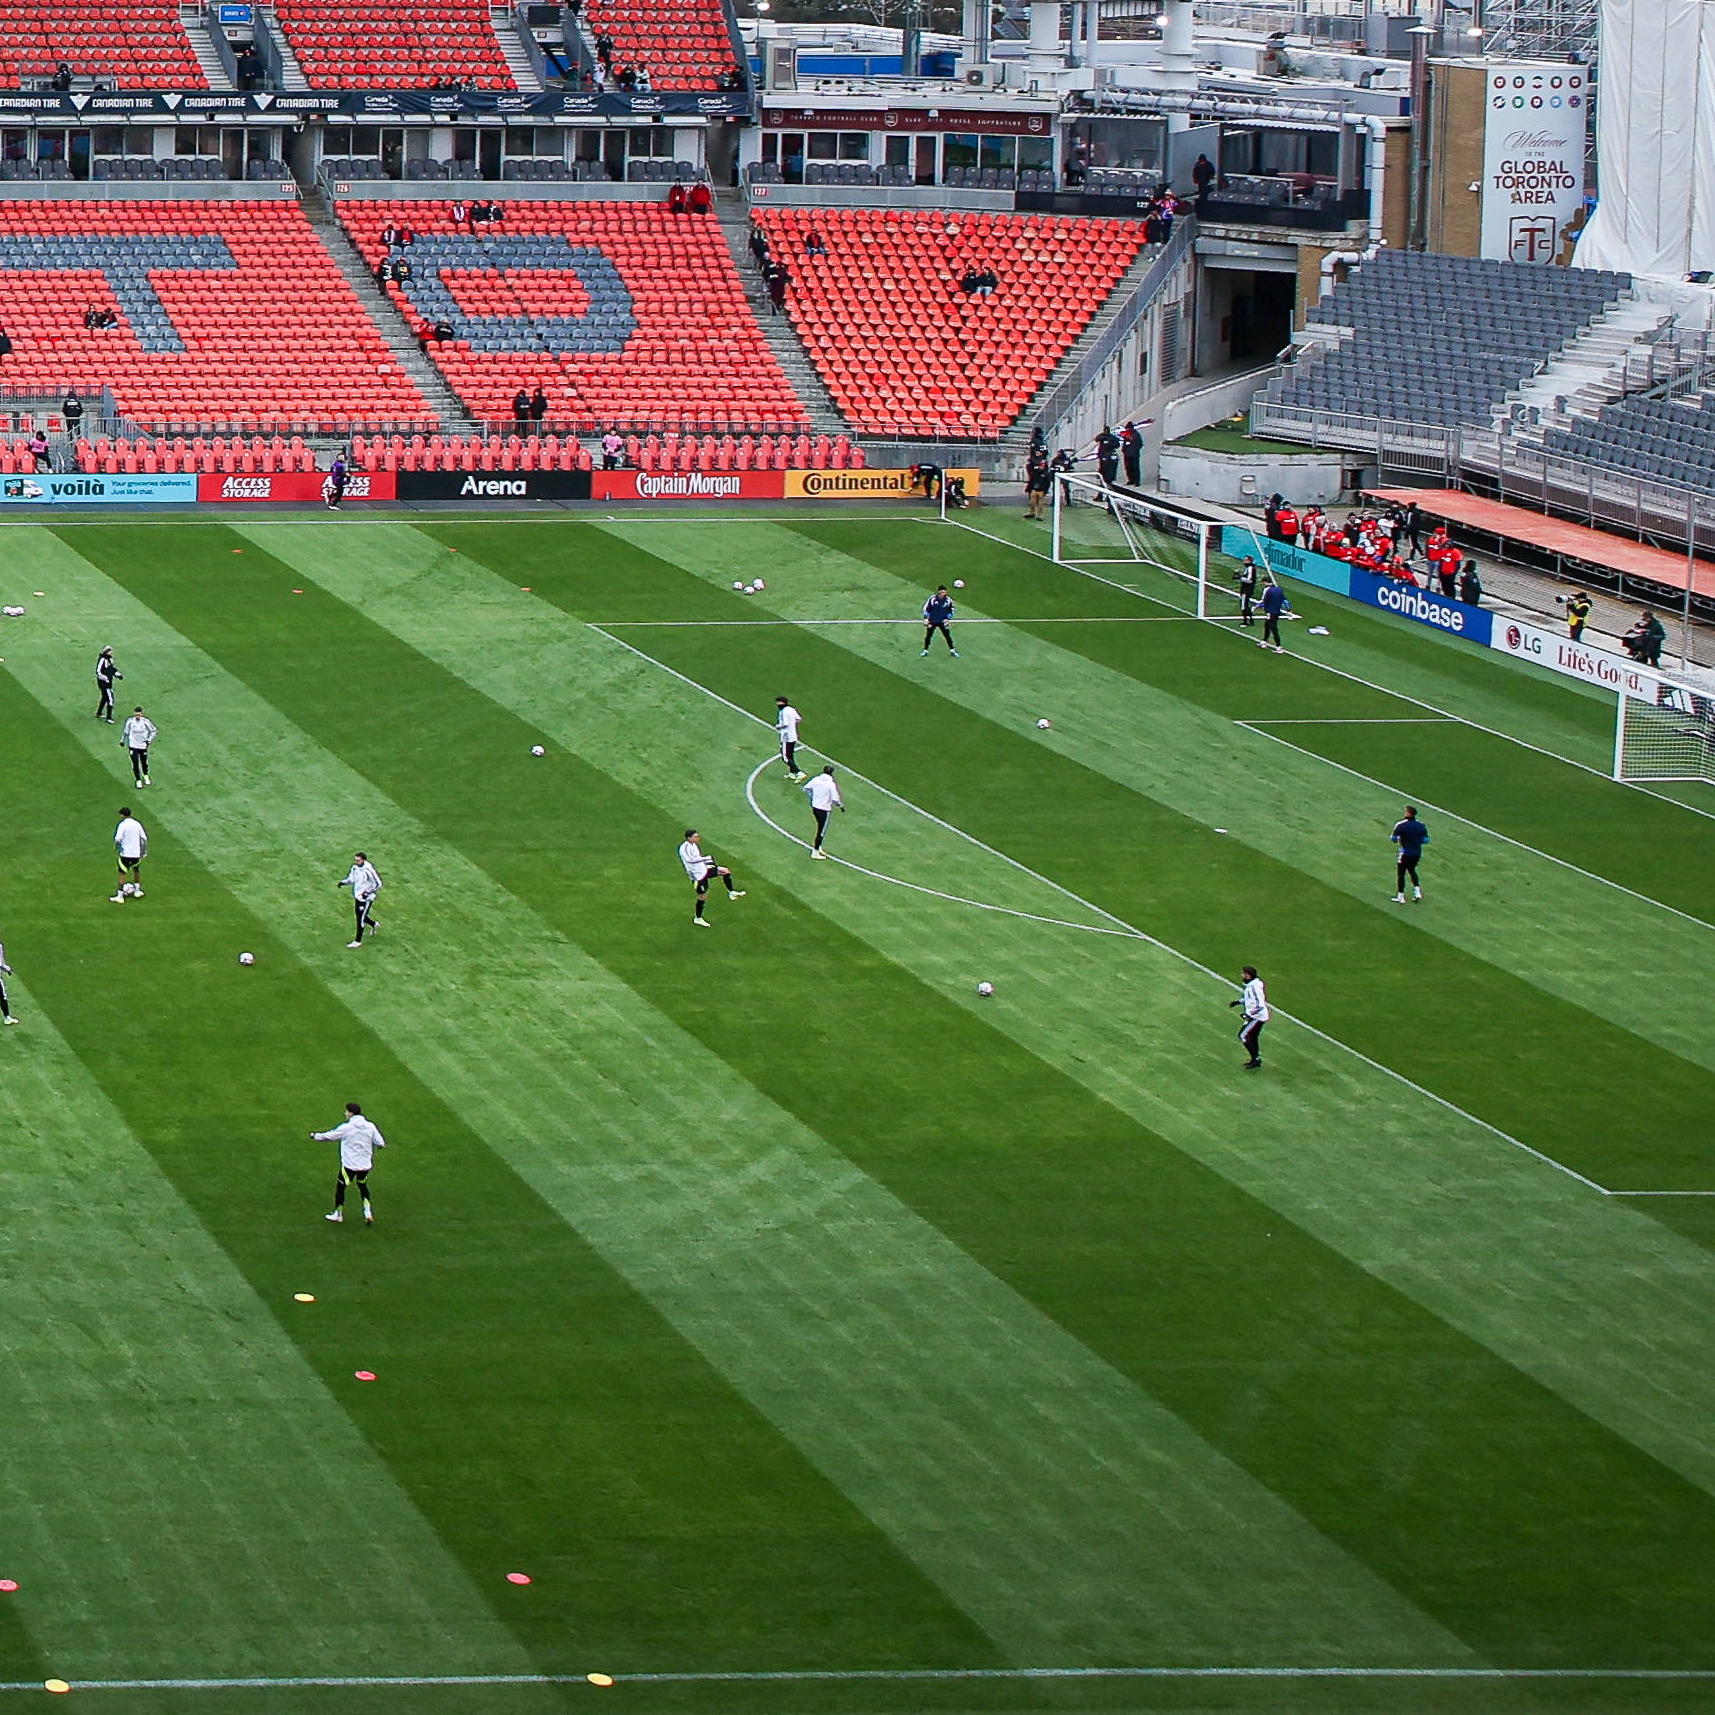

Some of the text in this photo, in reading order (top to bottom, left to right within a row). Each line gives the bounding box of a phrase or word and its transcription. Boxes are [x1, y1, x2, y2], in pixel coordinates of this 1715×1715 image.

[0, 97, 61, 108] CANADIAN TIRE
[92, 97, 153, 108] CANADIAN TIRE
[184, 97, 246, 108] CANADIAN TIRE
[275, 97, 340, 108] CANADIAN TIRE
[1503, 130, 1570, 152] Welcome
[1500, 160, 1569, 175] GLOBAL
[1493, 175, 1576, 189] TORONTO
[1510, 190, 1556, 204] AREA
[222, 476, 271, 489] ACCESS
[321, 476, 371, 488] AESS
[460, 475, 527, 496] Arena
[636, 473, 741, 497] Captain Morgan
[801, 472, 905, 494] Continental
[221, 488, 271, 498] STORAGE
[321, 488, 371, 498] STRAGE
[1377, 585, 1465, 634] coinbase
[1524, 633, 1542, 655] LG
[1557, 645, 1643, 693] Life's God.
